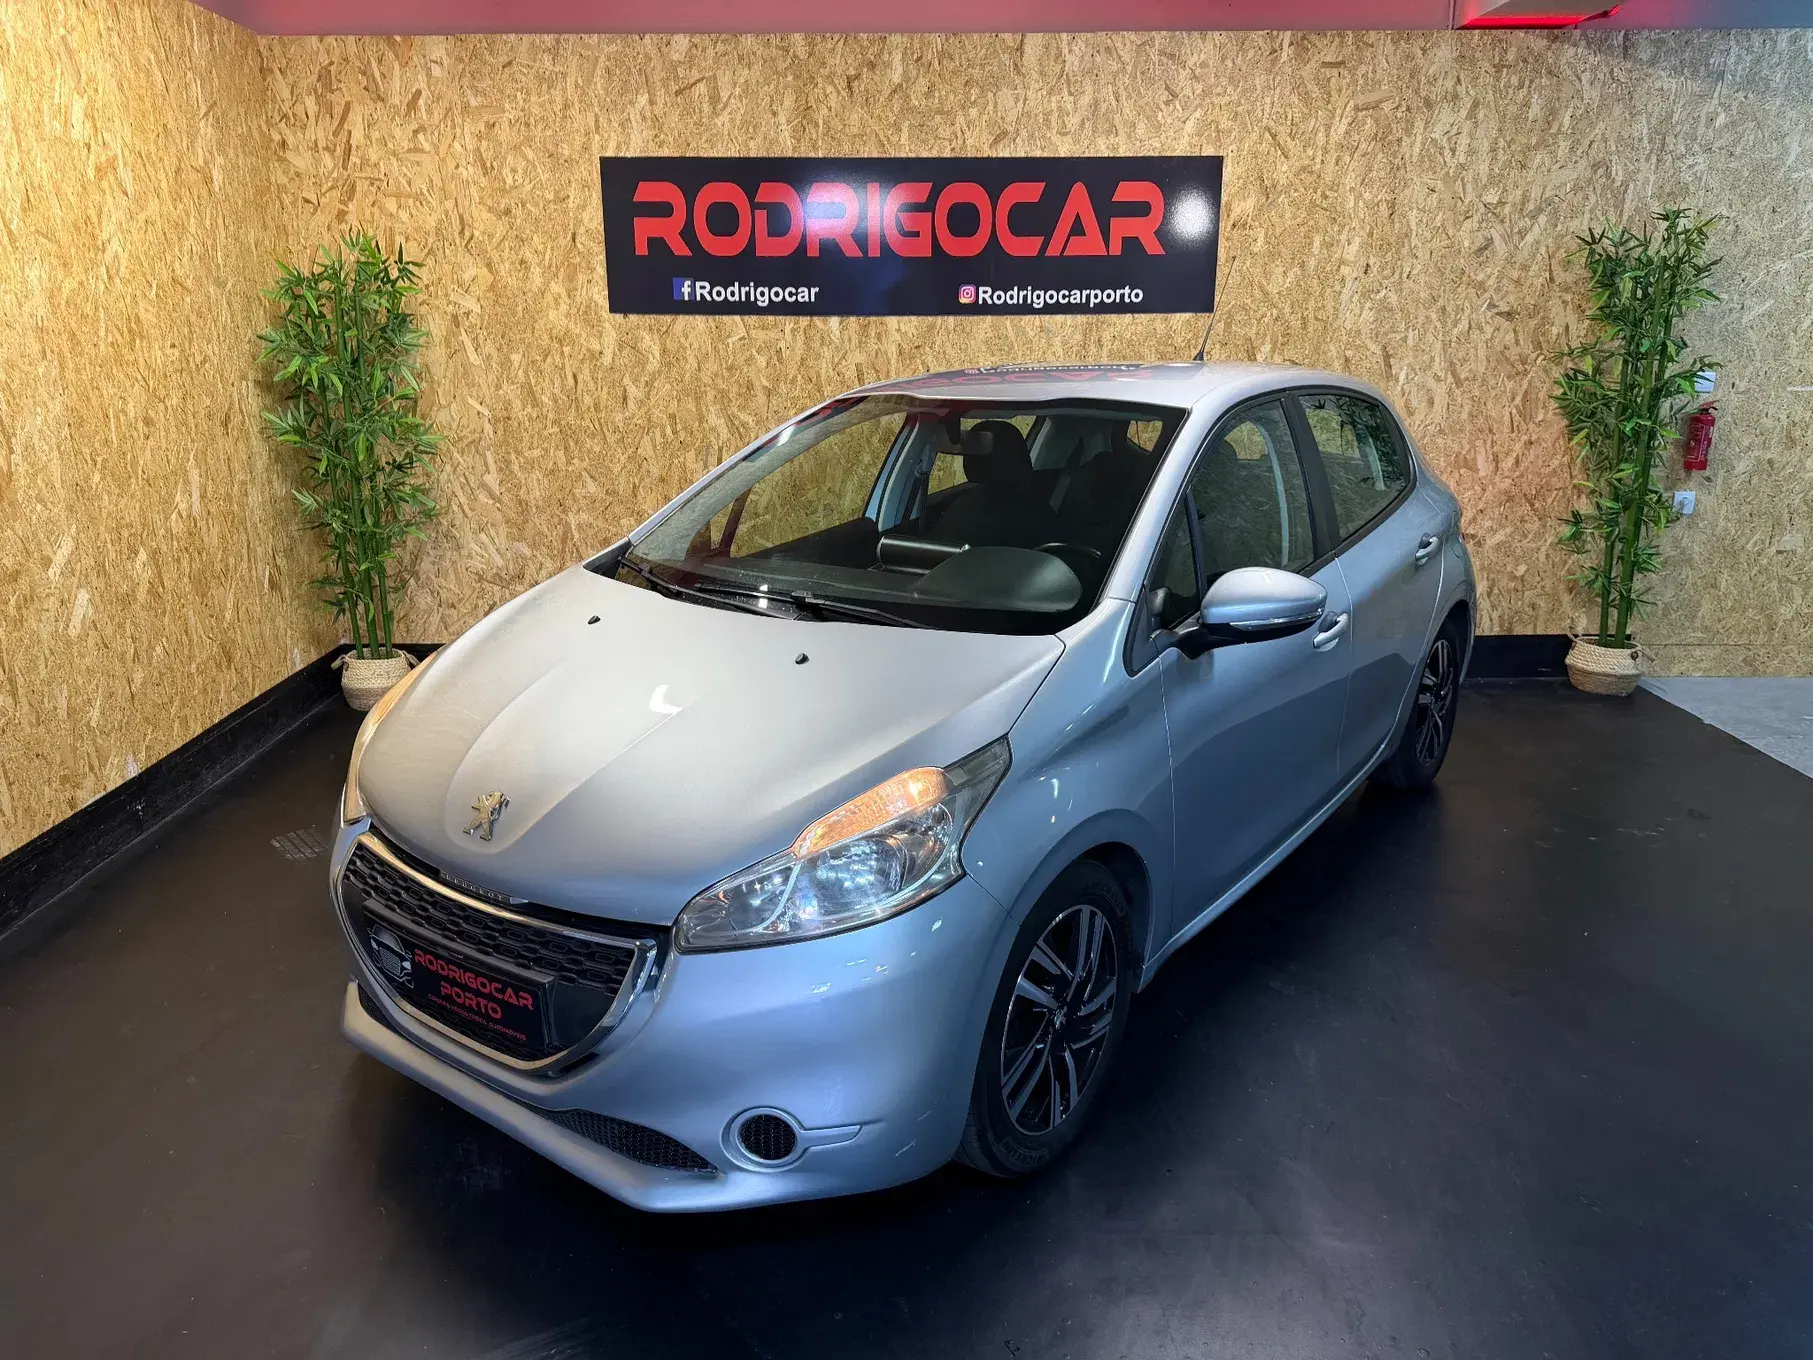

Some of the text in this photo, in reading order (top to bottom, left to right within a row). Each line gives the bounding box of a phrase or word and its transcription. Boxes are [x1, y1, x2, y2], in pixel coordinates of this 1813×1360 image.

[633, 181, 1166, 257] RODRIGOCAR
[695, 281, 820, 307] Rodrigocar
[978, 285, 1144, 308] Rodrigocarporto
[414, 948, 534, 1011] RODRIGOCAR
[440, 981, 502, 1019] PORTO
